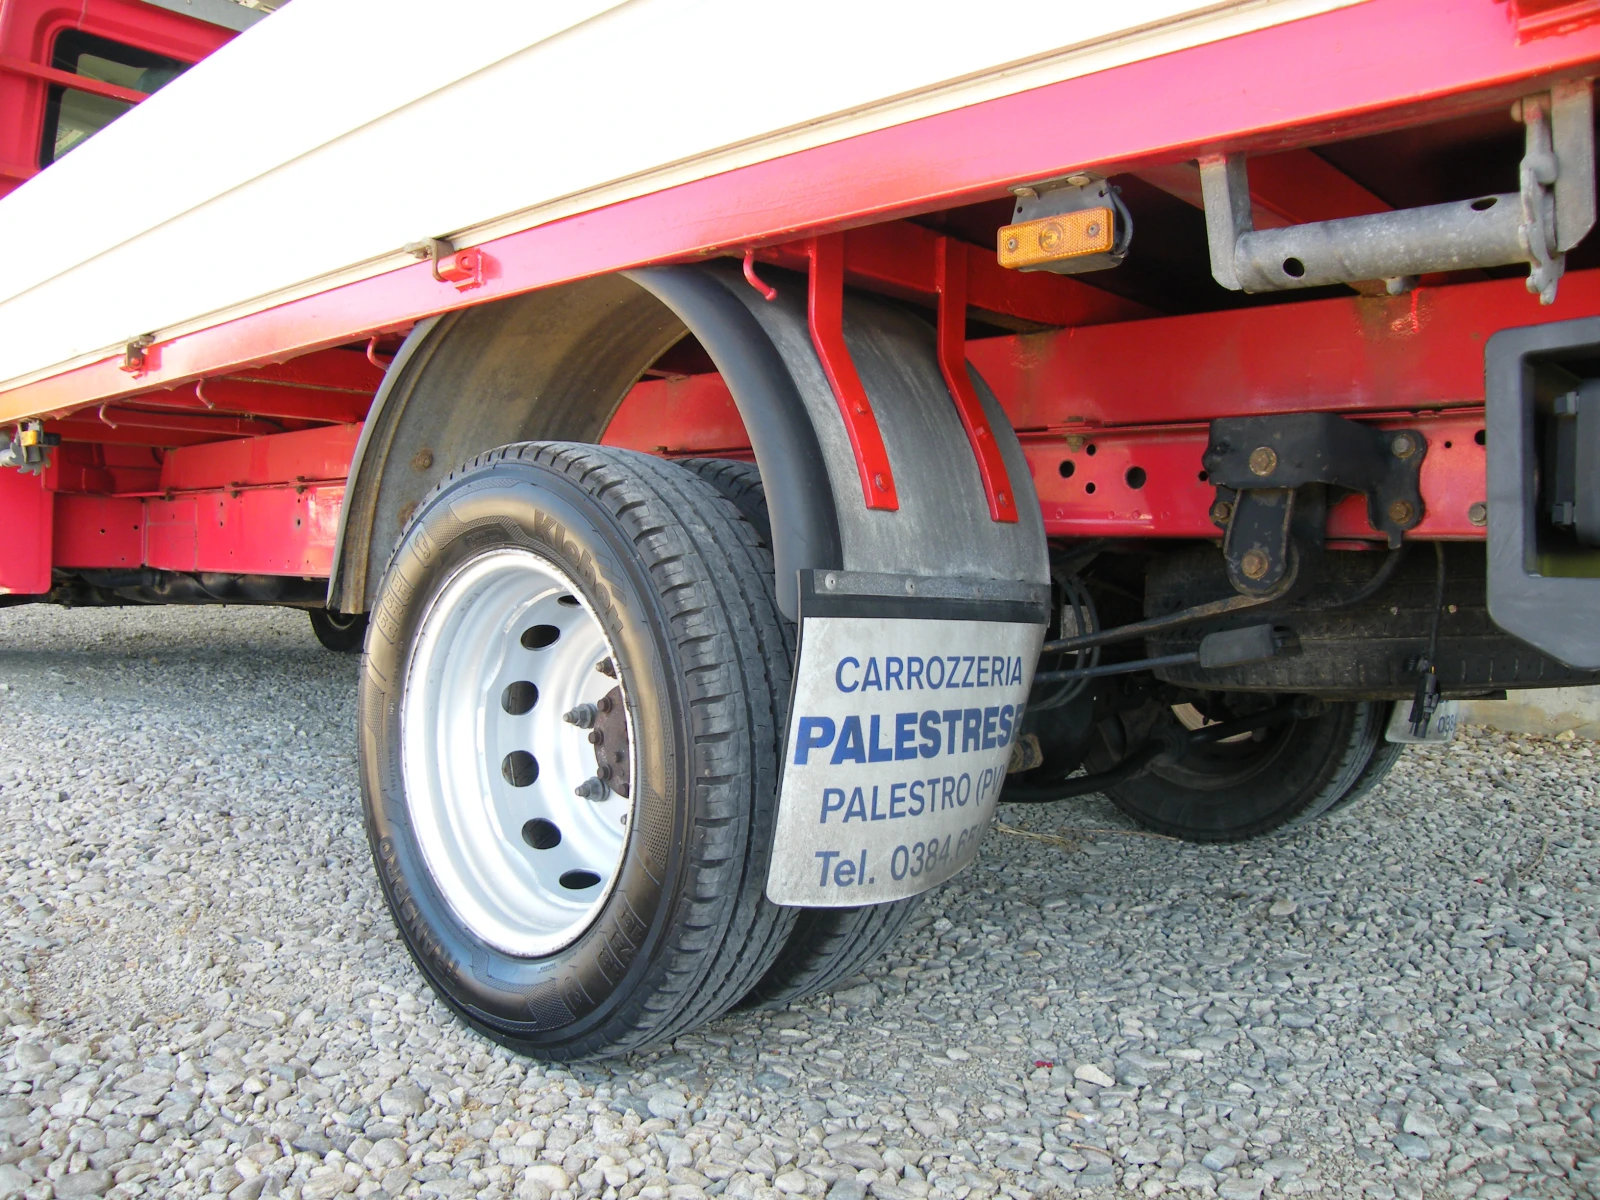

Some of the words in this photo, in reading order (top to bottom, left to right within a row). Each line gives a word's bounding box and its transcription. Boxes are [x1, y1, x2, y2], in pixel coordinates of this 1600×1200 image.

[835, 655, 1022, 693] CARROZZERIA
[819, 772, 971, 824] PALESTRO
[814, 848, 876, 888] Tel.
[379, 835, 460, 986] TRANSPRO
